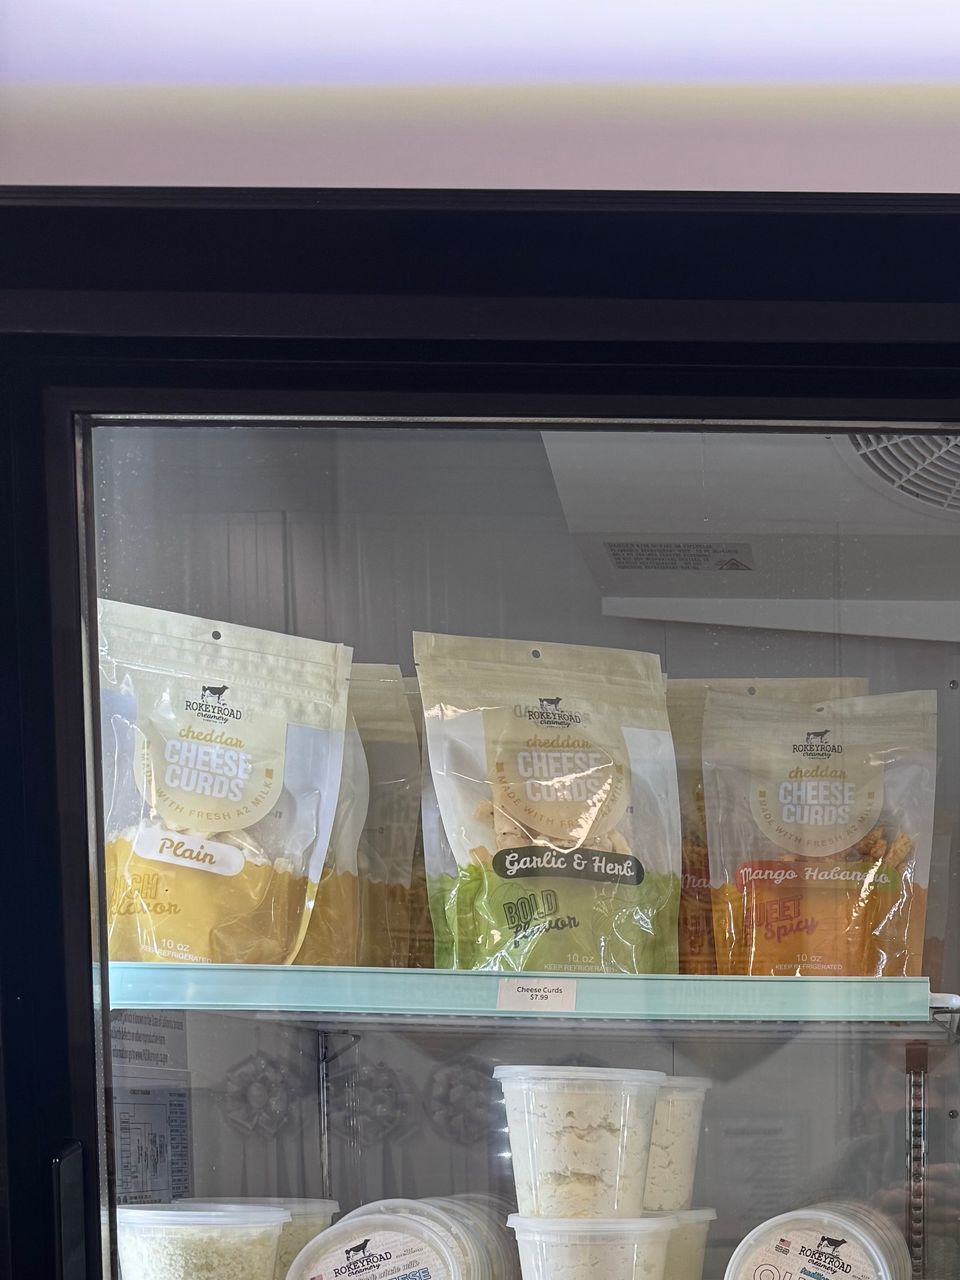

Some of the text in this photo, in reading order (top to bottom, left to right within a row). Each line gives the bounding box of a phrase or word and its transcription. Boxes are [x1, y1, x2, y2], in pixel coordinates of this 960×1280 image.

[185, 700, 242, 720] ROKEYROAD
[179, 727, 245, 750] cheddar
[792, 744, 842, 754] ROKEYROAD
[165, 740, 252, 779] CHEESE
[164, 765, 243, 803] CURDS
[788, 766, 848, 779] cheddar
[780, 781, 856, 805] CHEESE
[782, 804, 850, 826] CURDS
[159, 838, 216, 866] Plain
[505, 852, 635, 877] Garlic & Herb
[740, 868, 797, 884] Mango
[334, 1252, 392, 1278] ROKEYROAD
[798, 1246, 852, 1274] ROKEYROAD
